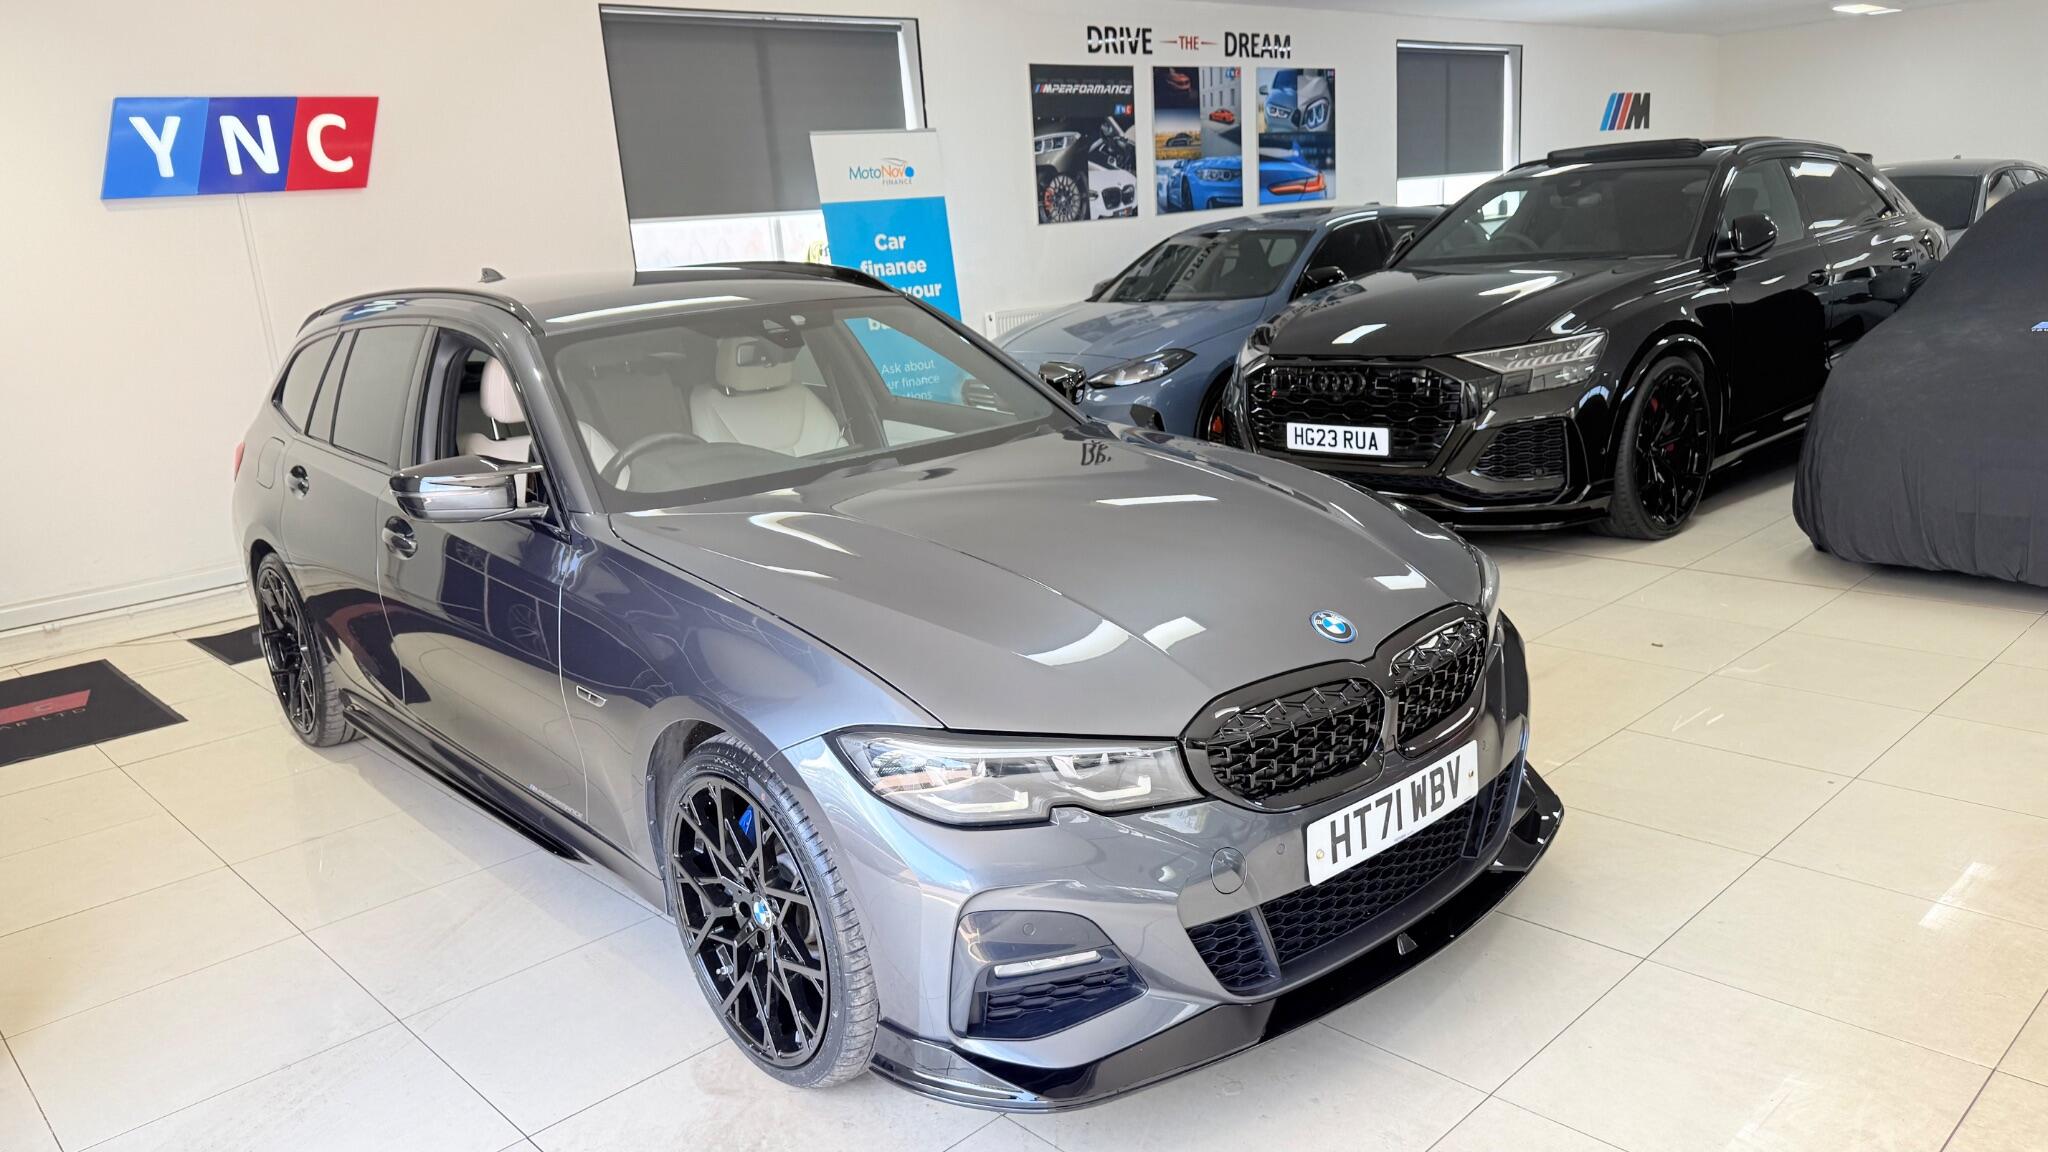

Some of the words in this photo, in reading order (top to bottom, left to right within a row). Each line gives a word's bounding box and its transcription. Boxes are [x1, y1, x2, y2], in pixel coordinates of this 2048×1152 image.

[1087, 26, 1153, 55] DRIVE
[1178, 35, 1200, 51] THE
[1224, 31, 1291, 59] DREAM
[128, 113, 354, 178] YNC
[849, 164, 915, 180] MotoNovo
[882, 178, 913, 186] FINANCE
[874, 233, 906, 251] Car
[860, 259, 928, 278] finance
[881, 362, 902, 375] Ask
[904, 359, 936, 372] about
[902, 375, 940, 389] finance
[1294, 426, 1338, 448] HG23
[1343, 430, 1379, 451] RUA
[1330, 788, 1403, 865] HT71
[1411, 754, 1461, 823] WBV
